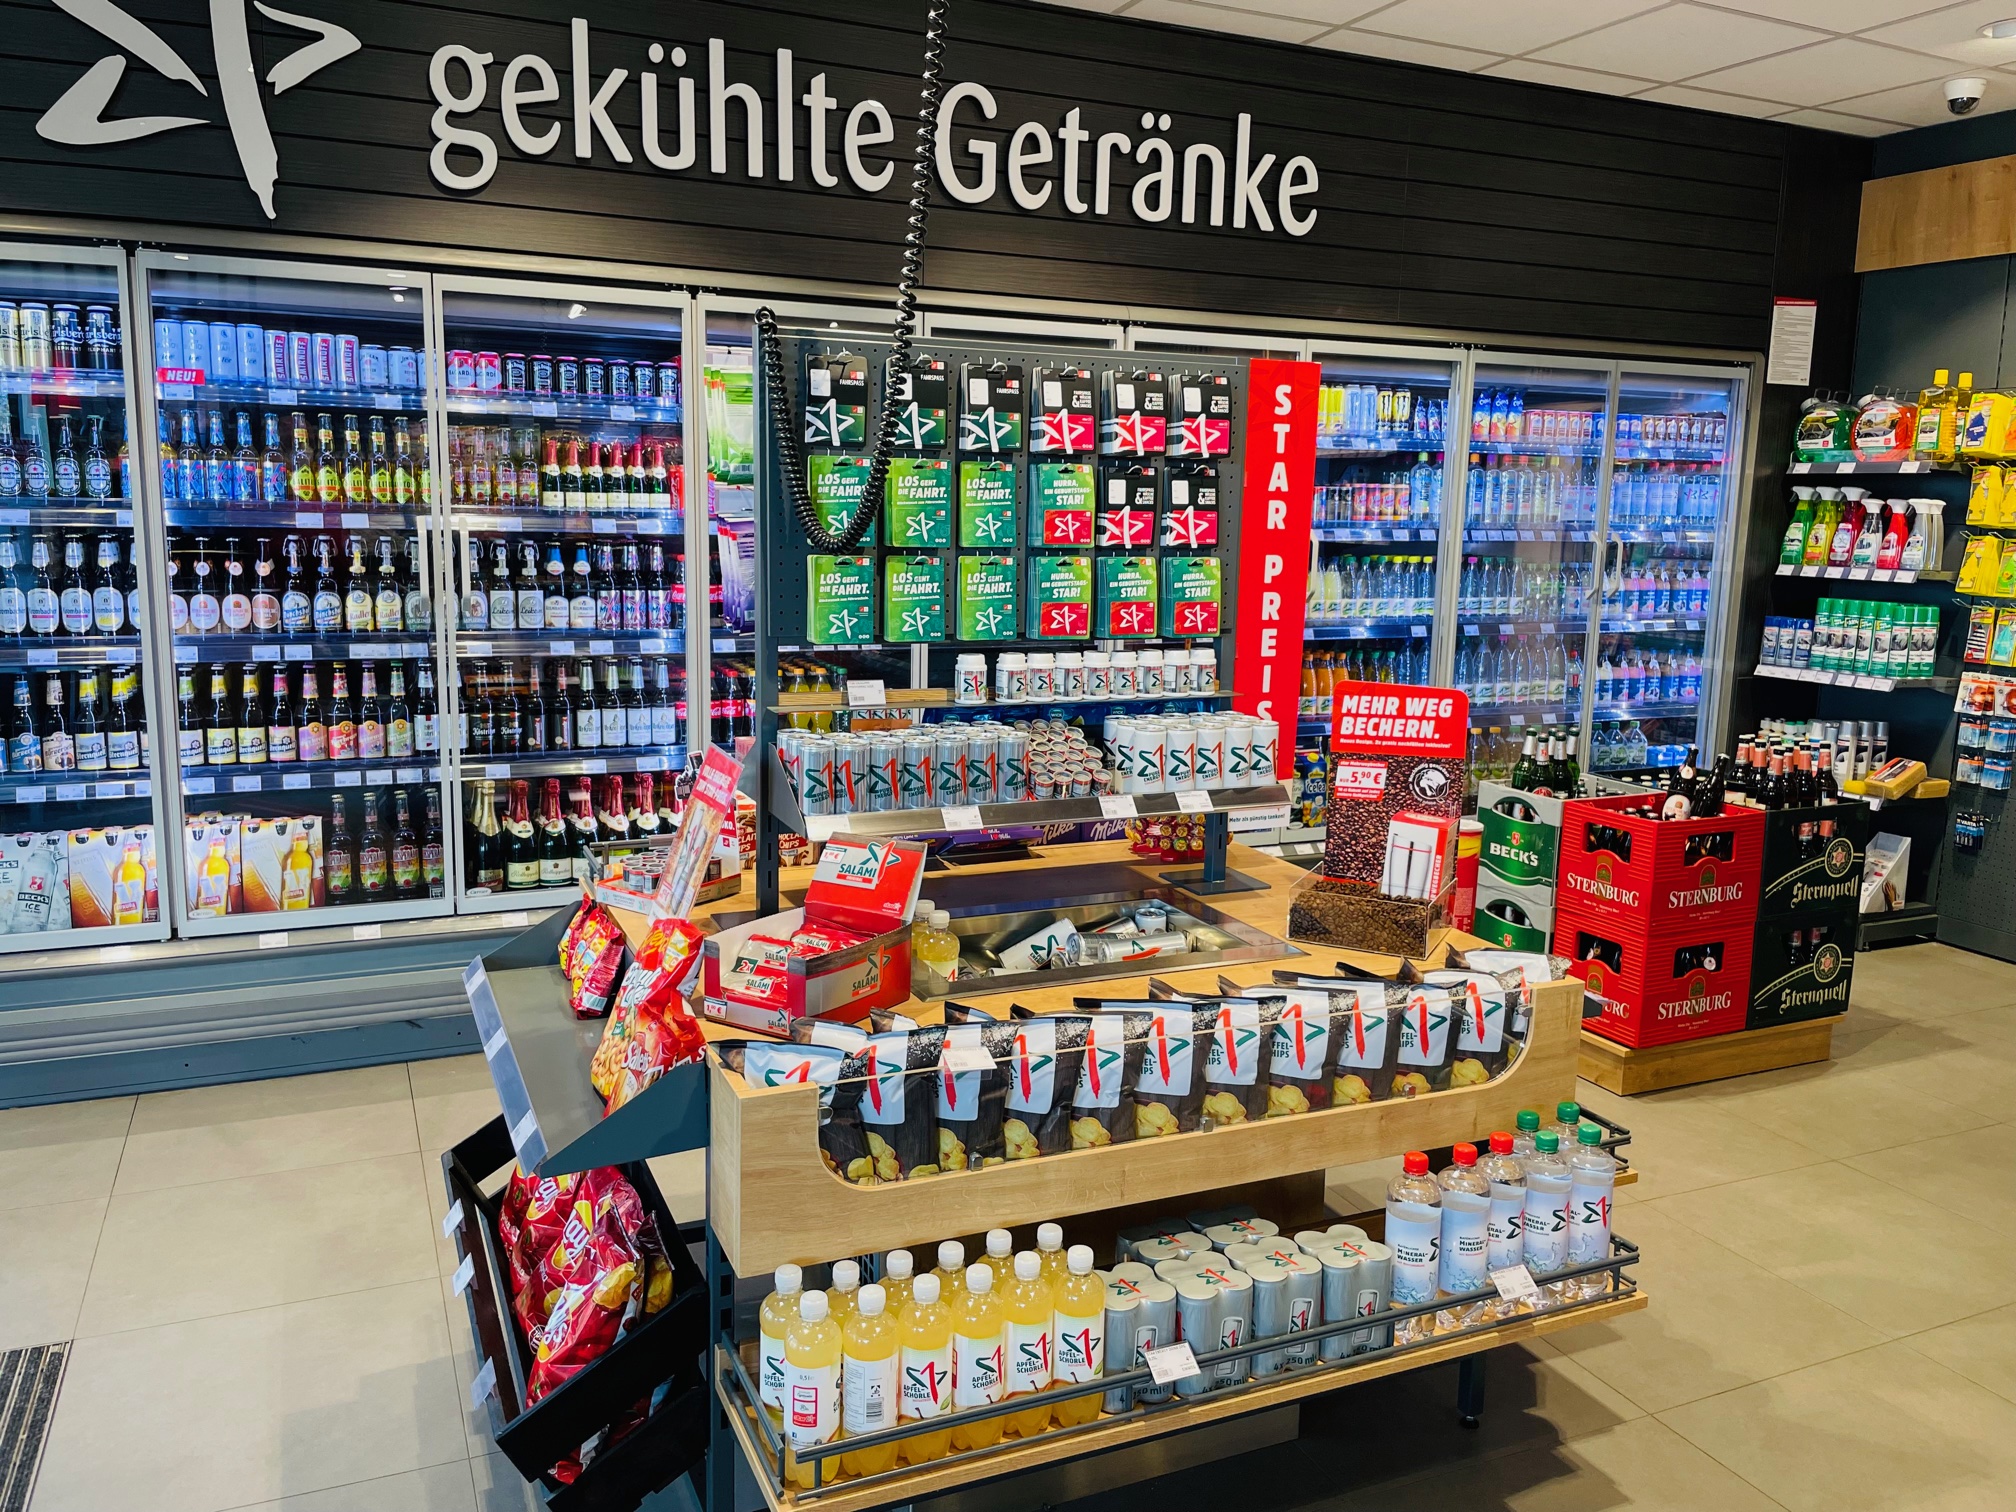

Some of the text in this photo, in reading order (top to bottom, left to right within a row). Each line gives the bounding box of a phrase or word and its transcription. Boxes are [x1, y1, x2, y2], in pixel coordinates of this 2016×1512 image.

[429, 17, 1320, 237] gekühlte Getränke
[276, 336, 285, 380] SMIRNOFF
[299, 339, 309, 381] SMIRNOFF
[321, 341, 331, 384] SMIRNOFF
[345, 341, 355, 385] SMIRNOFF
[166, 371, 197, 382] NEU!
[818, 473, 840, 485] LOS
[898, 475, 919, 487] LOS
[966, 478, 987, 489] LOS
[1053, 480, 1079, 488] HURRA,
[909, 487, 947, 498] FAHRT.
[977, 489, 1012, 501] FAHRT.
[1056, 494, 1085, 506] STAR!
[1256, 384, 1292, 721] STAR PREIS
[820, 573, 841, 584] LOS
[892, 572, 913, 584] LOS
[966, 572, 987, 584] LOS
[1182, 573, 1206, 581] HURRA,
[831, 583, 870, 595] FAHRT.
[904, 582, 941, 594] FAHRT.
[978, 582, 1014, 594] FAHRT.
[1053, 587, 1081, 598] STAR!
[1120, 587, 1147, 598] STAR!
[1184, 587, 1211, 598] STAR!
[1341, 695, 1453, 718] MEHR WEG
[1340, 716, 1440, 739] BECHERN.
[1373, 773, 1382, 784] €
[1250, 815, 1267, 823] günstig
[1091, 818, 1128, 845] Milka
[1489, 842, 1539, 867] BECK'S
[838, 863, 877, 878] SALAMI
[1566, 872, 1640, 908] STERNBURG
[1668, 882, 1743, 909] STERNBURG
[1790, 874, 1859, 909] Sternquell
[18, 892, 50, 905] BECK'S
[25, 902, 41, 912] ICE
[805, 938, 828, 948] SALAMI
[764, 951, 786, 963] SALAMI
[738, 960, 752, 973] 2x
[746, 979, 770, 990] SALAMI
[852, 976, 879, 991] SALAMI
[1779, 979, 1848, 1015] Sternquell
[1657, 991, 1732, 1020] STERNBURG
[767, 1020, 788, 1030] SALAMI
[1397, 1254, 1424, 1263] WASSER
[1058, 1349, 1081, 1358] APFEL-
[1058, 1355, 1086, 1364] SCHORLE
[1304, 1354, 1315, 1364] ml
[1016, 1360, 1040, 1368] APFEL-
[1016, 1363, 1044, 1374] SCHORLE
[764, 1373, 785, 1382] APFEL-
[972, 1373, 995, 1383] APFEL-
[972, 1376, 999, 1389] SCHORLE
[1233, 1376, 1247, 1386] ml
[903, 1384, 925, 1393] APFEL-
[1148, 1385, 1162, 1395] ml
[903, 1391, 931, 1399] SCHORLE
